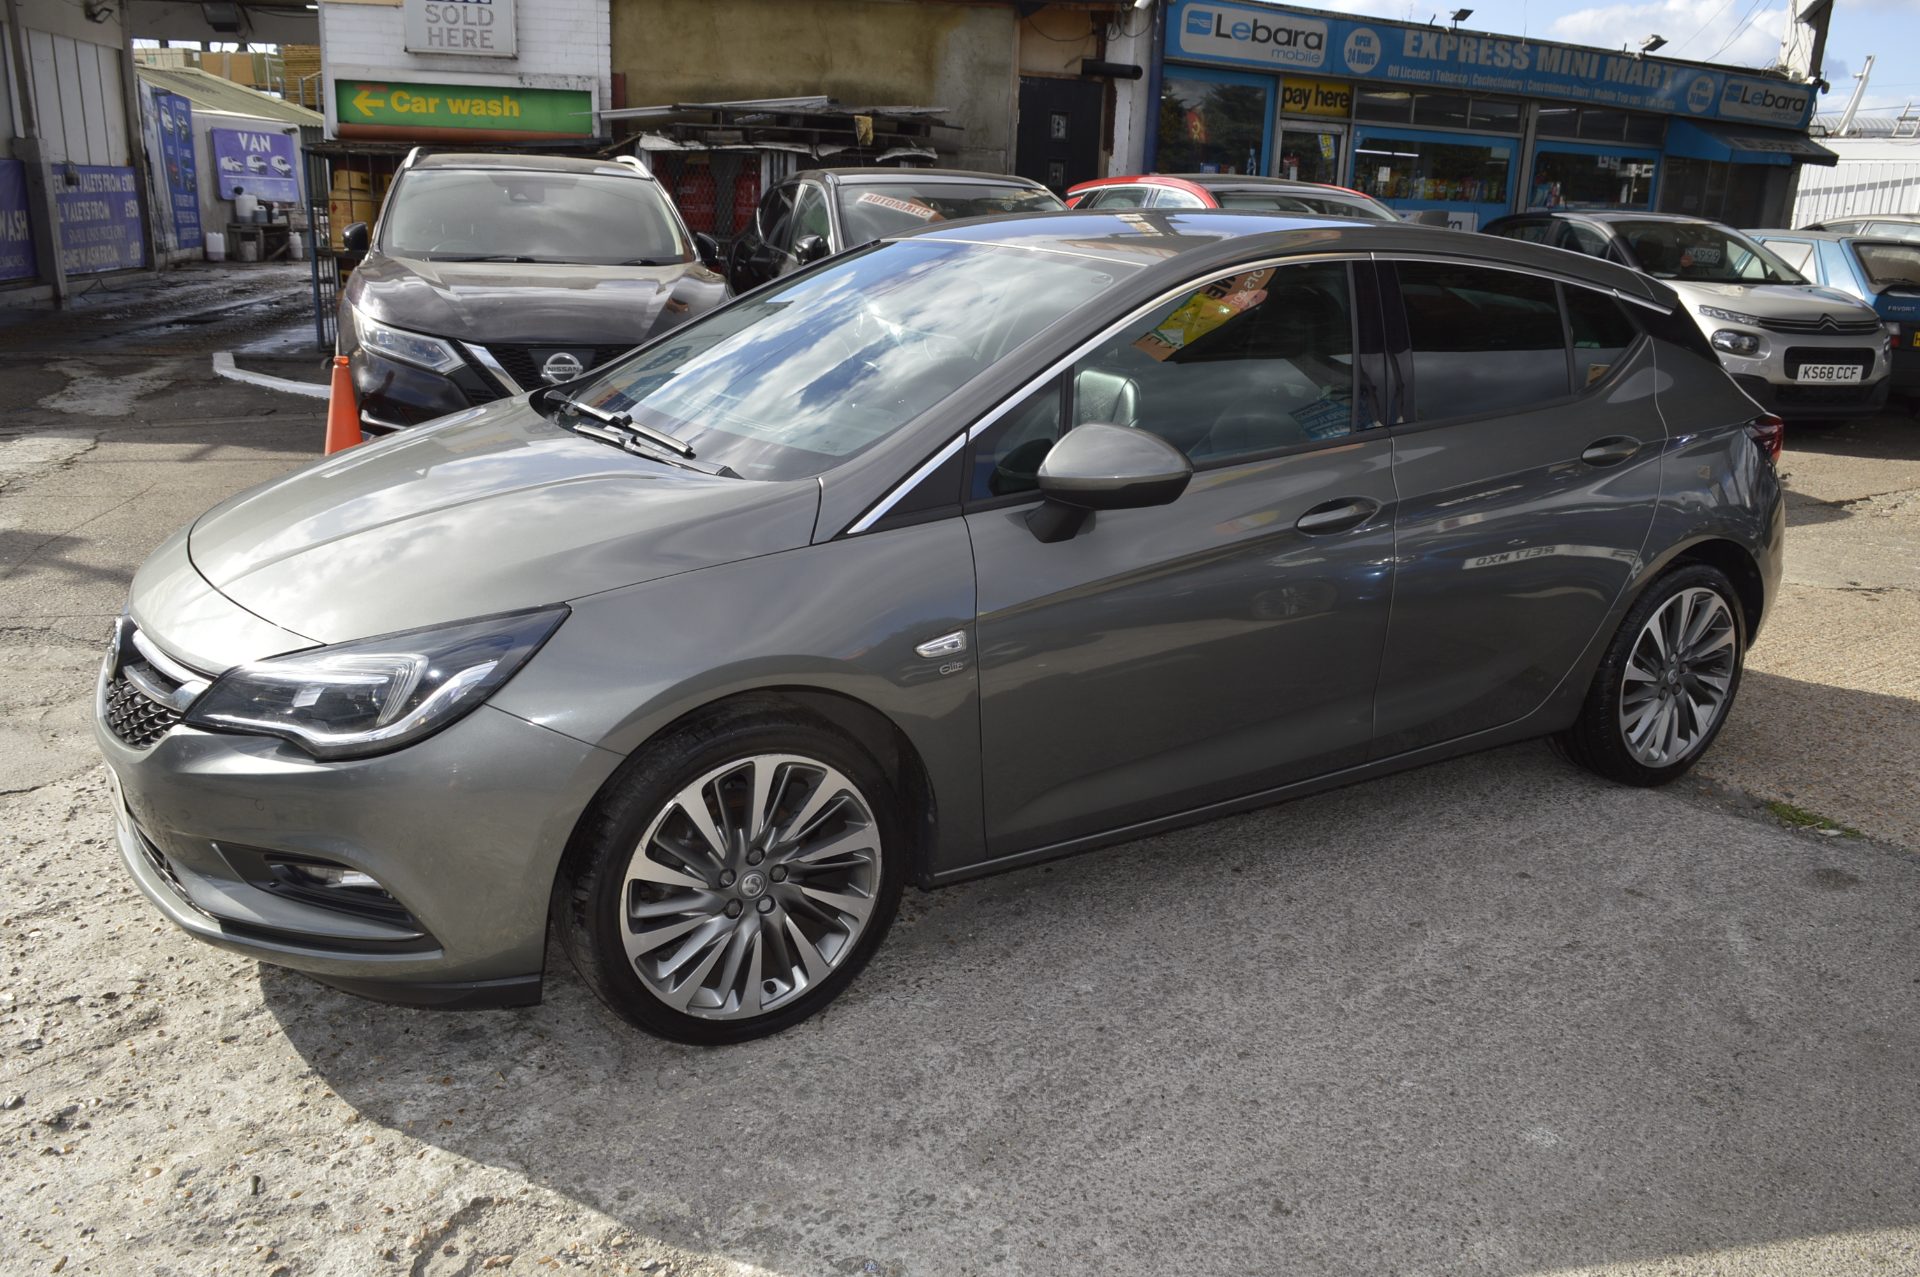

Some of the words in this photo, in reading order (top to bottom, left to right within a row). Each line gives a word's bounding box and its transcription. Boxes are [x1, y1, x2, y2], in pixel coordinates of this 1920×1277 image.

[425, 4, 495, 28] SOLD
[427, 26, 495, 50] HERE
[1215, 13, 1323, 50] Lebara
[1354, 34, 1371, 47] OPEN
[1271, 48, 1320, 63] mobile
[1403, 29, 1531, 70] EXPRESS
[1536, 45, 1601, 79] MINI
[1604, 56, 1676, 91] MART
[1387, 65, 1400, 78] Off
[1401, 66, 1431, 81] Licence
[1436, 70, 1468, 85] Tobacco
[1472, 74, 1523, 90] Confectionery
[390, 90, 440, 114] Car
[447, 95, 521, 118] wash
[1281, 86, 1312, 110] pay
[1314, 83, 1349, 108] here
[1740, 85, 1807, 112] Lebara
[237, 132, 272, 152] VAN
[863, 194, 931, 217] AUTOMATIC
[547, 365, 579, 373] NISSAN
[1803, 366, 1834, 380] KS68
[1836, 366, 1859, 380] CCF
